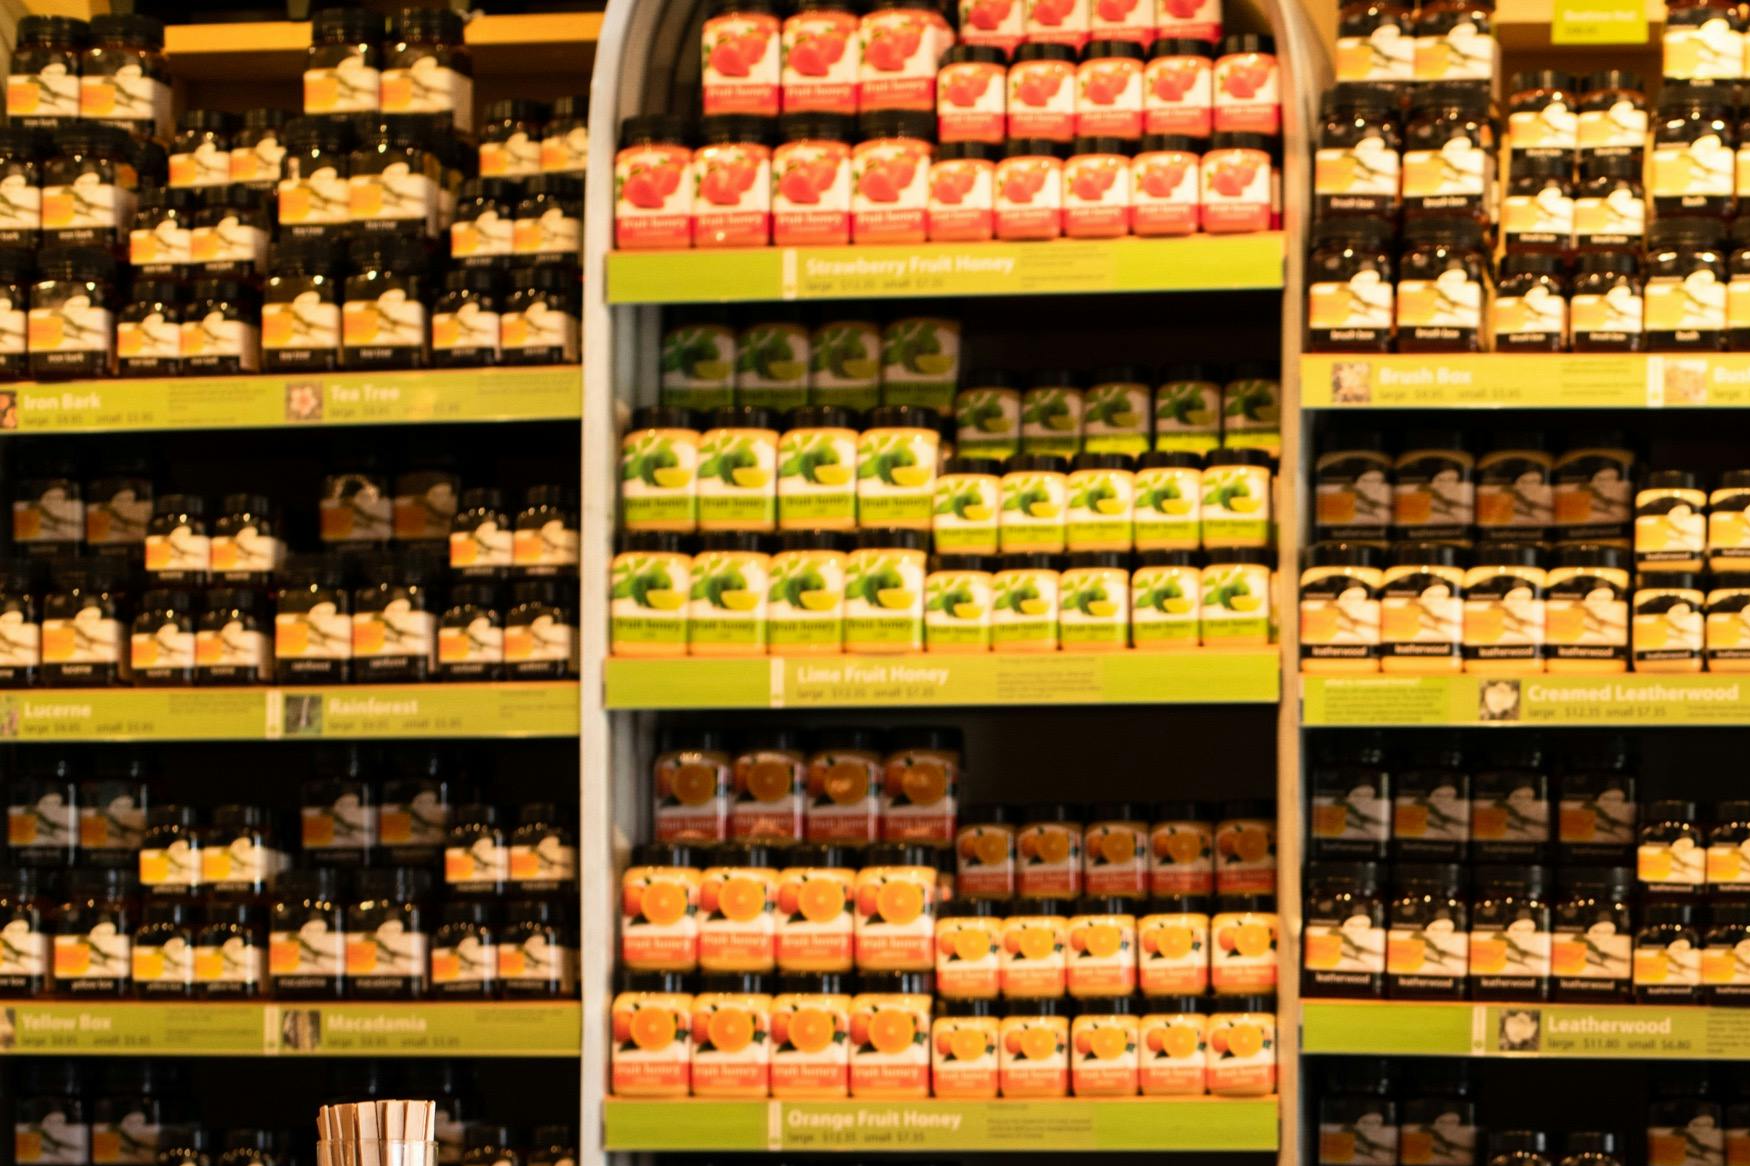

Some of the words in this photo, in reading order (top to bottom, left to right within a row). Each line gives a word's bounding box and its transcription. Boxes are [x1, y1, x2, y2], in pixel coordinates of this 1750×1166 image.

[805, 256, 906, 277] Strawberry
[910, 255, 952, 273] Fruit
[956, 255, 1015, 274] Honey
[1379, 367, 1433, 385] Brush
[1436, 367, 1472, 385] Box
[24, 394, 59, 410] Iron
[62, 393, 101, 409] Bark
[331, 385, 360, 402] Tea
[364, 384, 400, 401] Tree
[1312, 646, 1367, 656] leatherwood
[1394, 644, 1450, 655] leatherwood
[1479, 647, 1535, 657] leatherwood
[1558, 646, 1614, 657] leatherwood
[797, 666, 841, 684] Lime
[845, 665, 886, 683] Fruit
[891, 665, 950, 686] Honey
[1527, 684, 1611, 702] Creamed
[1615, 684, 1739, 702] Leatherwood
[24, 703, 92, 719] Lucerne
[329, 698, 419, 715] Rainforest
[1315, 973, 1371, 984] leatherwood
[1398, 977, 1454, 988] leatherwood
[1481, 977, 1536, 988] leatherwood
[1560, 979, 1616, 990] leatherwood
[22, 1013, 77, 1031] Yellow
[80, 1014, 112, 1030] Box
[327, 1015, 427, 1032] Macadamia
[1548, 1016, 1672, 1035] Leatherwood
[788, 1109, 854, 1131] Orange
[858, 1109, 899, 1127] Fruit
[904, 1109, 962, 1131] Honey
